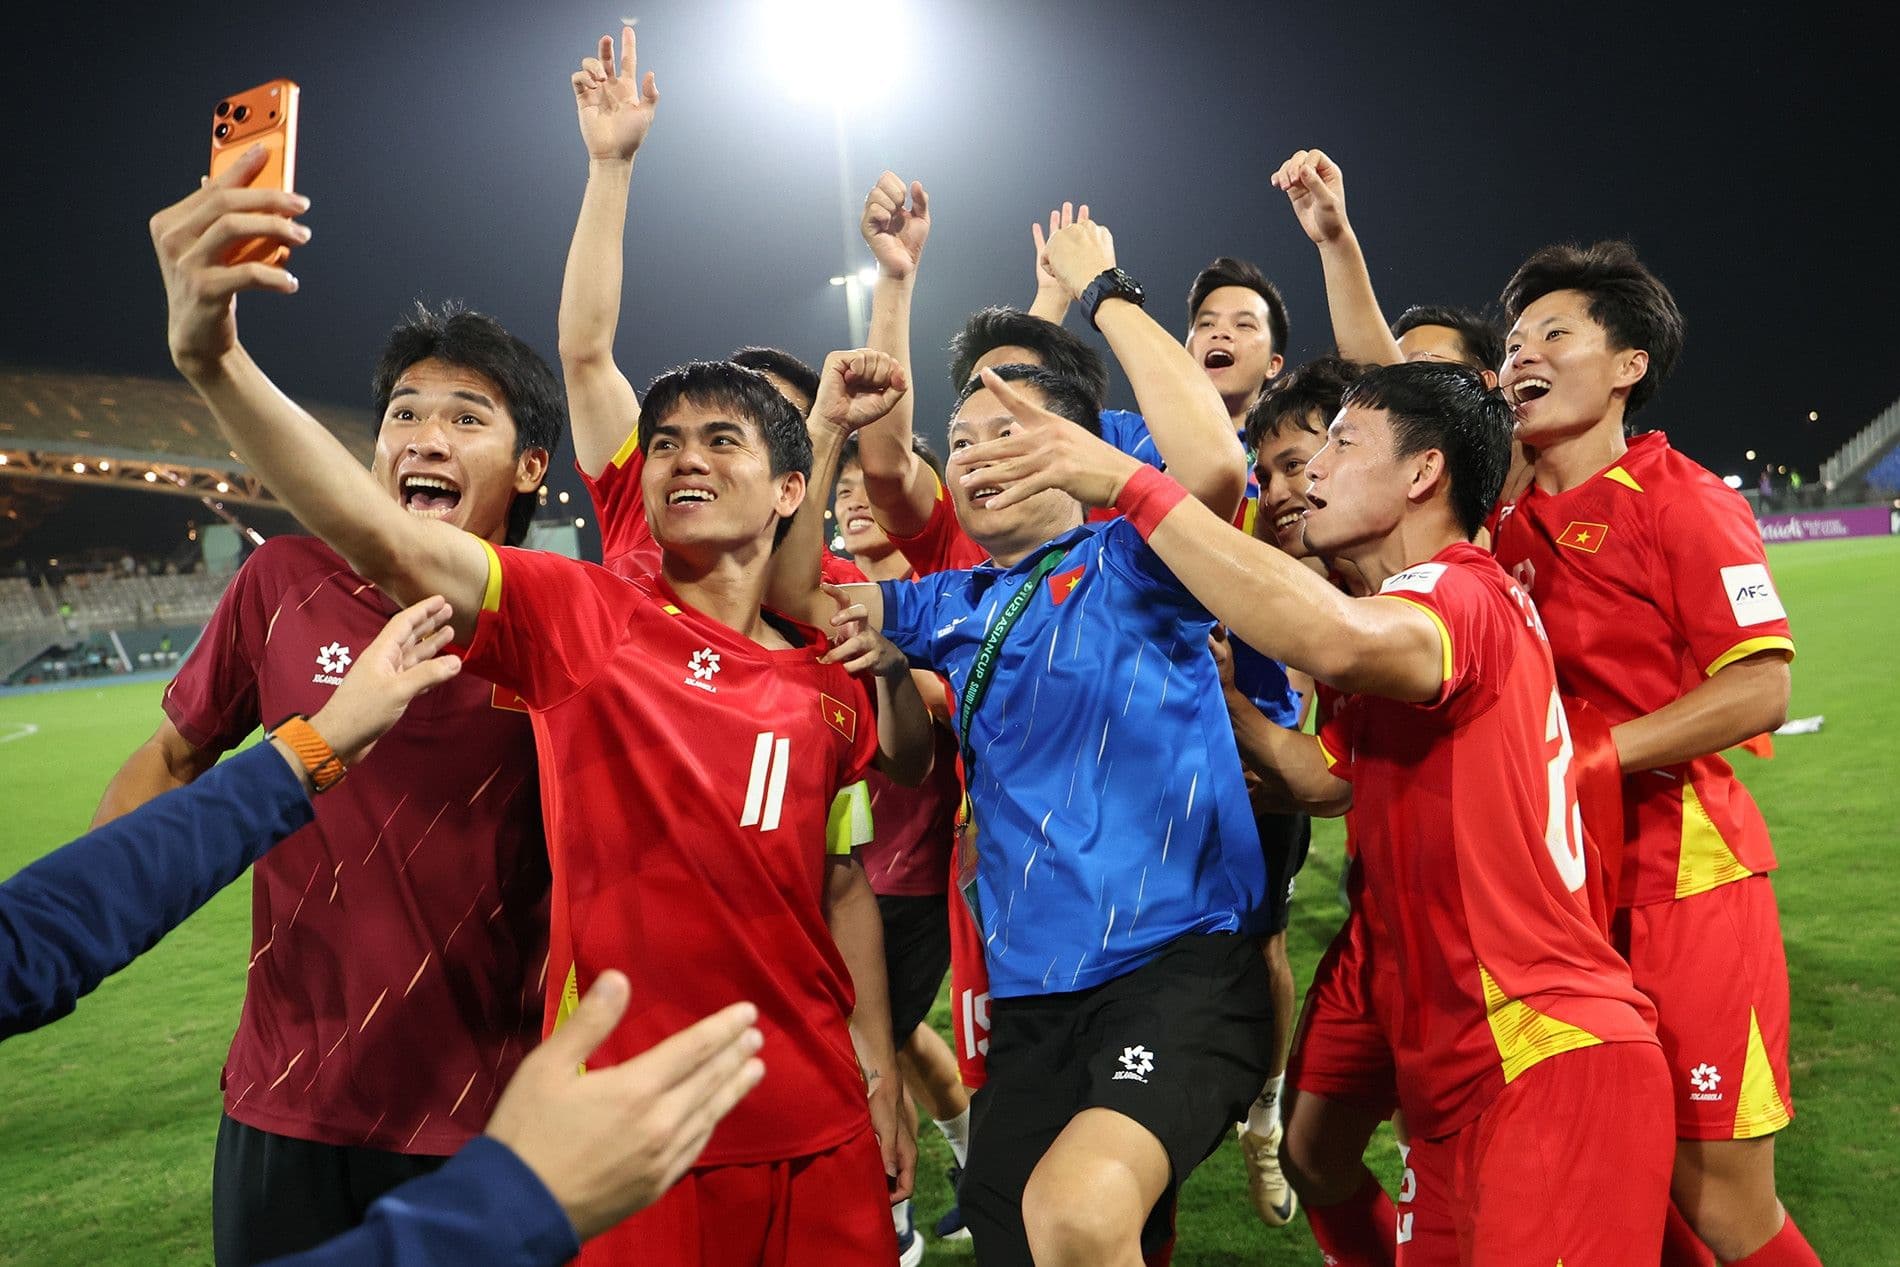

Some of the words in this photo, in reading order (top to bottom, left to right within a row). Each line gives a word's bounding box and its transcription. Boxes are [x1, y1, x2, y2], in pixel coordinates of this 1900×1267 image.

[1389, 571, 1433, 585] AFC
[1735, 584, 1769, 601] AFC
[1005, 596, 1024, 617] U23
[740, 731, 790, 832] 11
